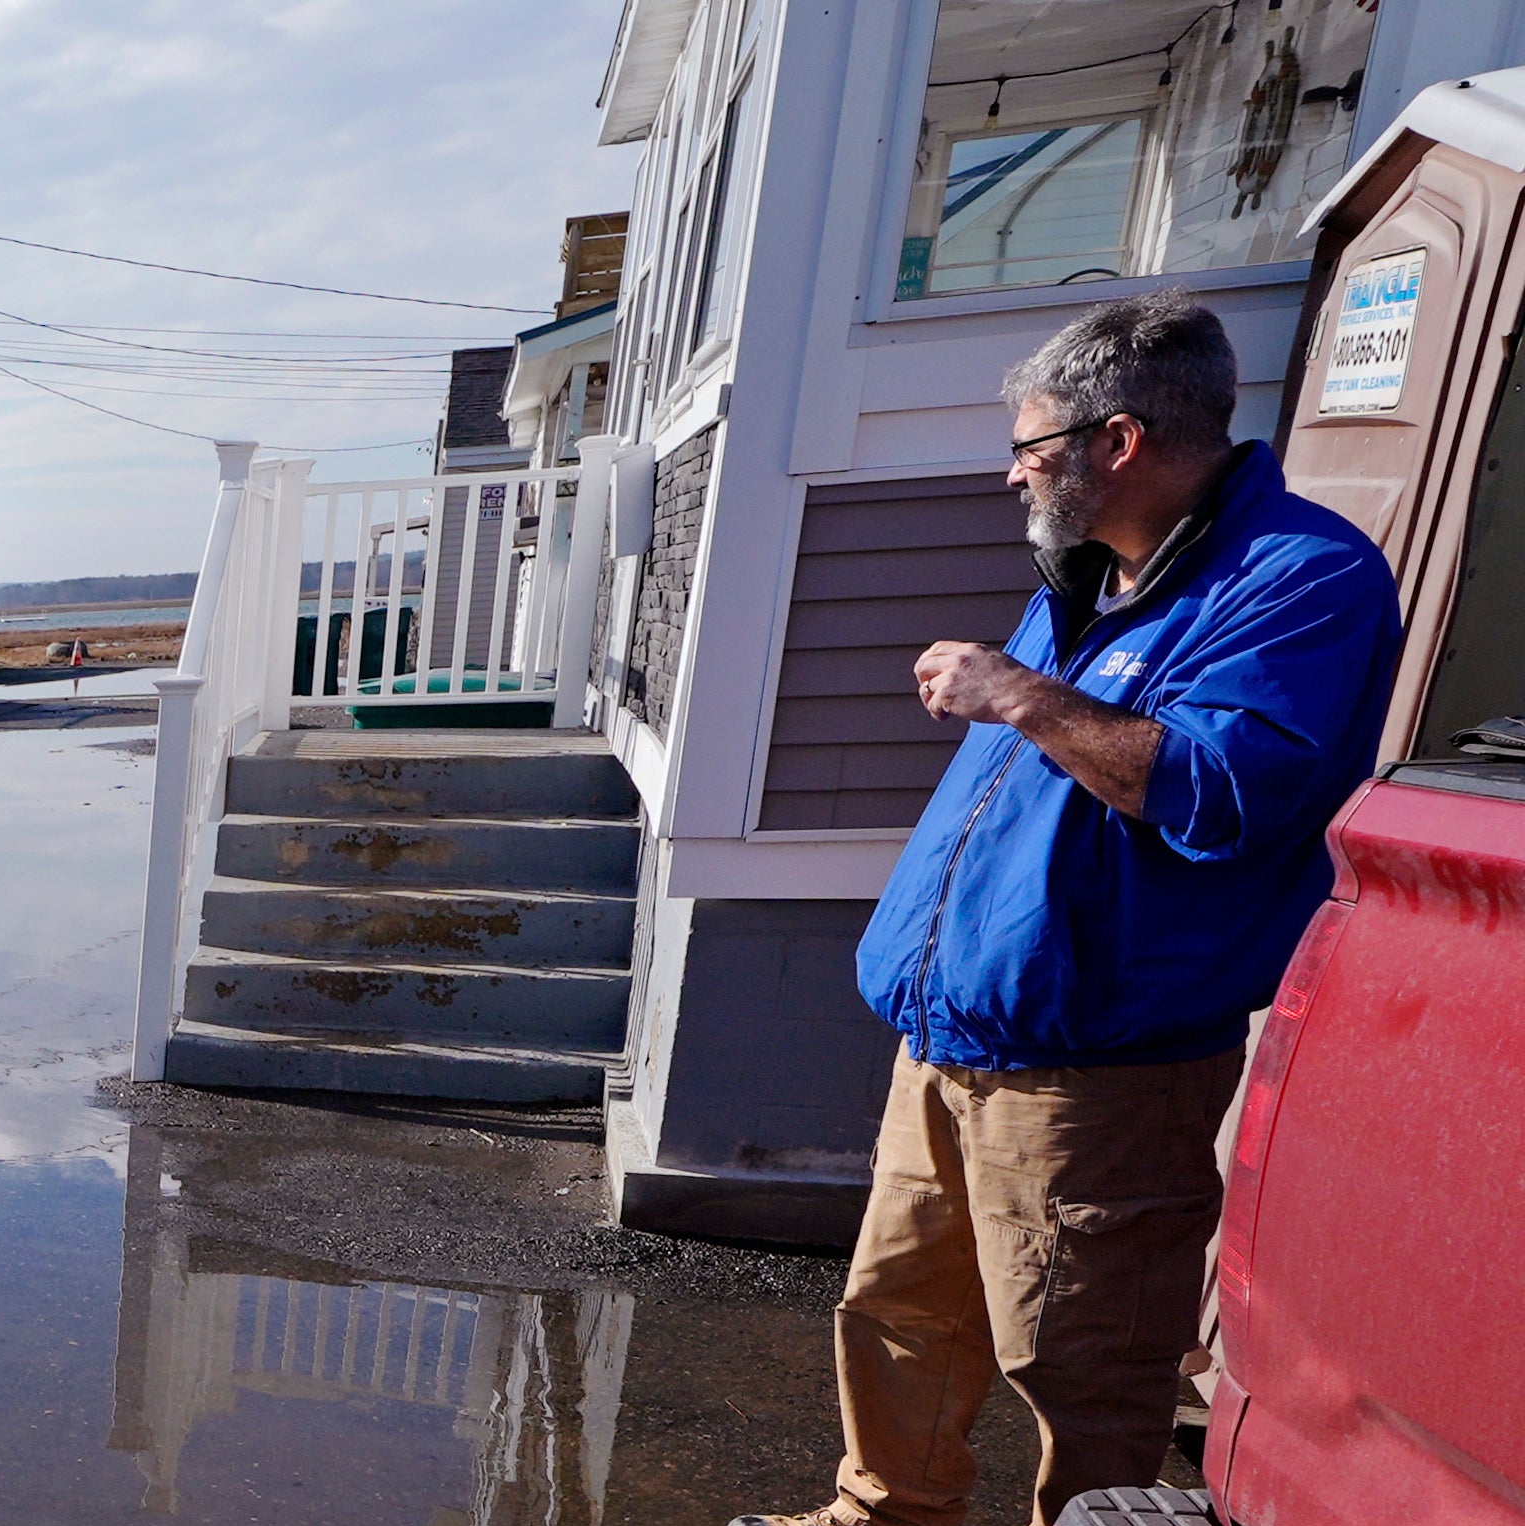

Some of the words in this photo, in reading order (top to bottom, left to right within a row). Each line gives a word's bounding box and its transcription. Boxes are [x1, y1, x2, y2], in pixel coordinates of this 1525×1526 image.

[1343, 261, 1424, 312] TRIANGLE
[1360, 374, 1402, 390] CLEANING
[482, 487, 504, 498] FO
